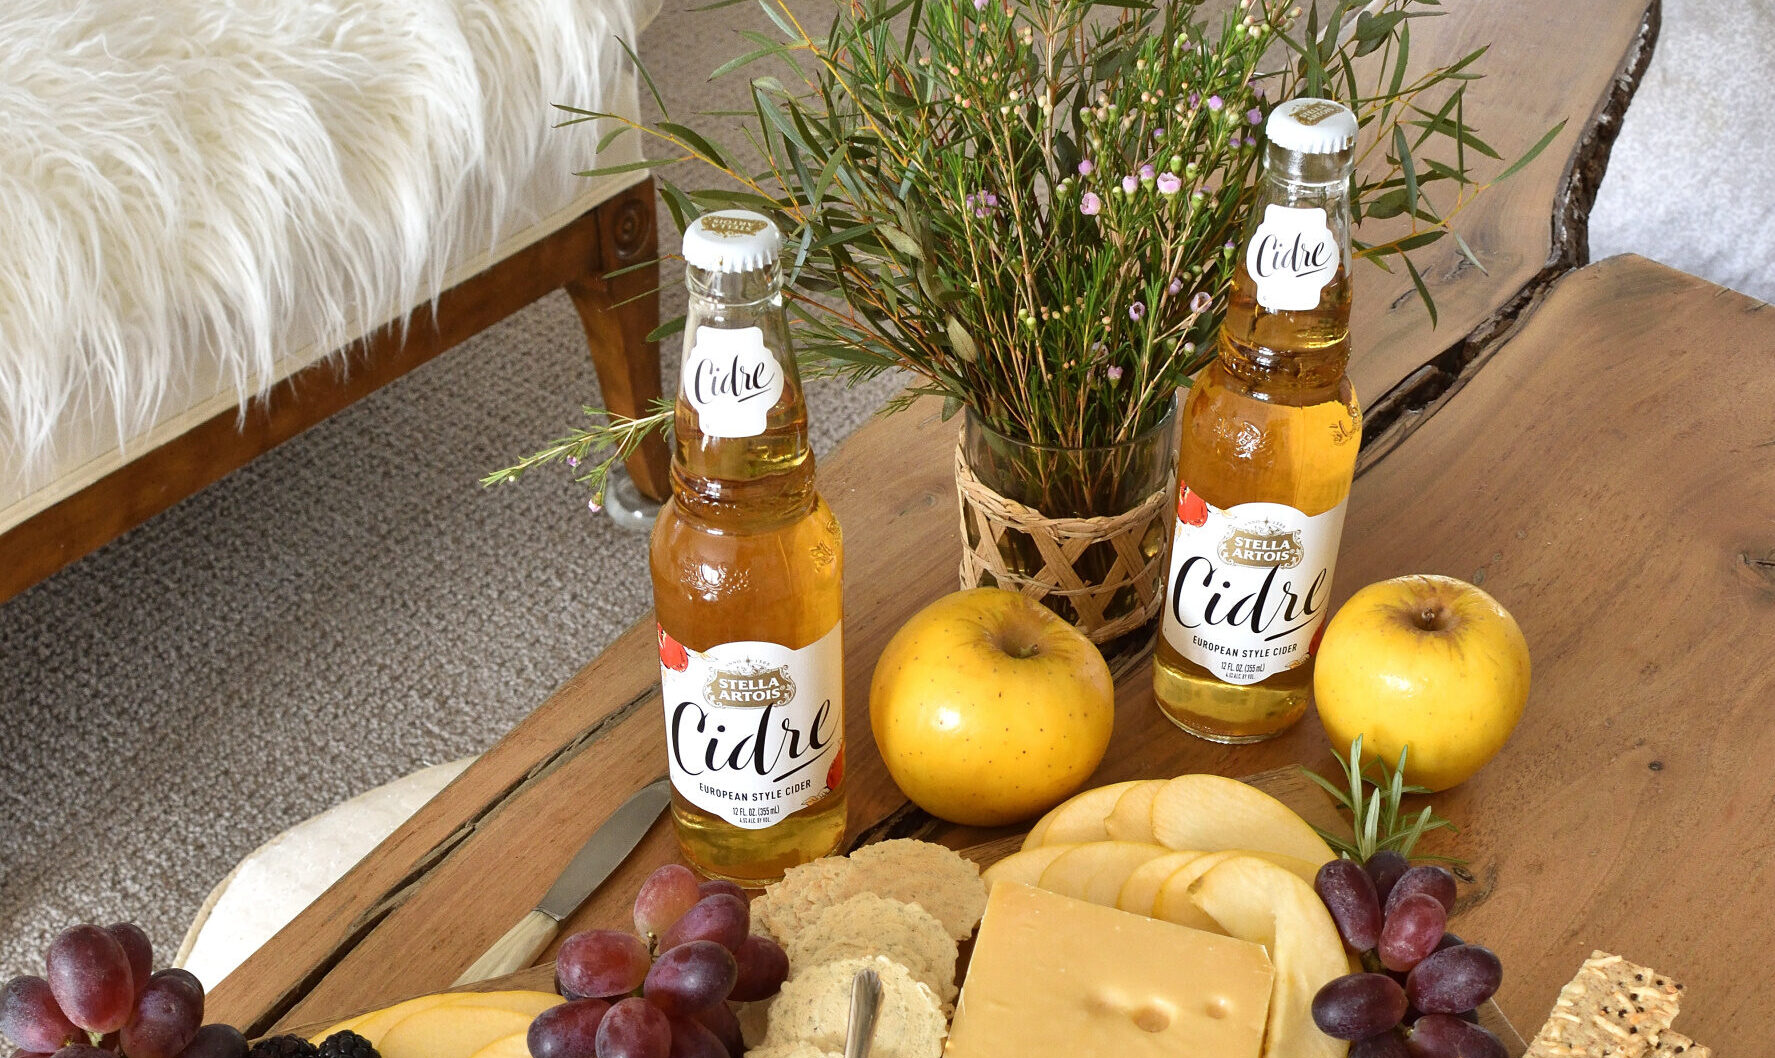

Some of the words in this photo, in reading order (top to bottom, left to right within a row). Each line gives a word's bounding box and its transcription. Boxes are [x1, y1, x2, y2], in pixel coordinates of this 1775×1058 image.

[1256, 232, 1332, 277] Cidre
[694, 354, 775, 404] Cidre
[1234, 536, 1290, 550] STELLA
[1173, 556, 1330, 634] Cidre
[1193, 635, 1239, 657] EUROPEAN
[1242, 648, 1271, 658] STYLE
[1273, 643, 1298, 656] CIDER
[1221, 661, 1227, 670] 12
[719, 677, 780, 690] STELLA
[672, 699, 840, 777] Cidre
[699, 782, 748, 801] EUROPEAN
[752, 789, 782, 802] STYLE
[785, 779, 811, 796] CIDER
[732, 807, 739, 816] 12
